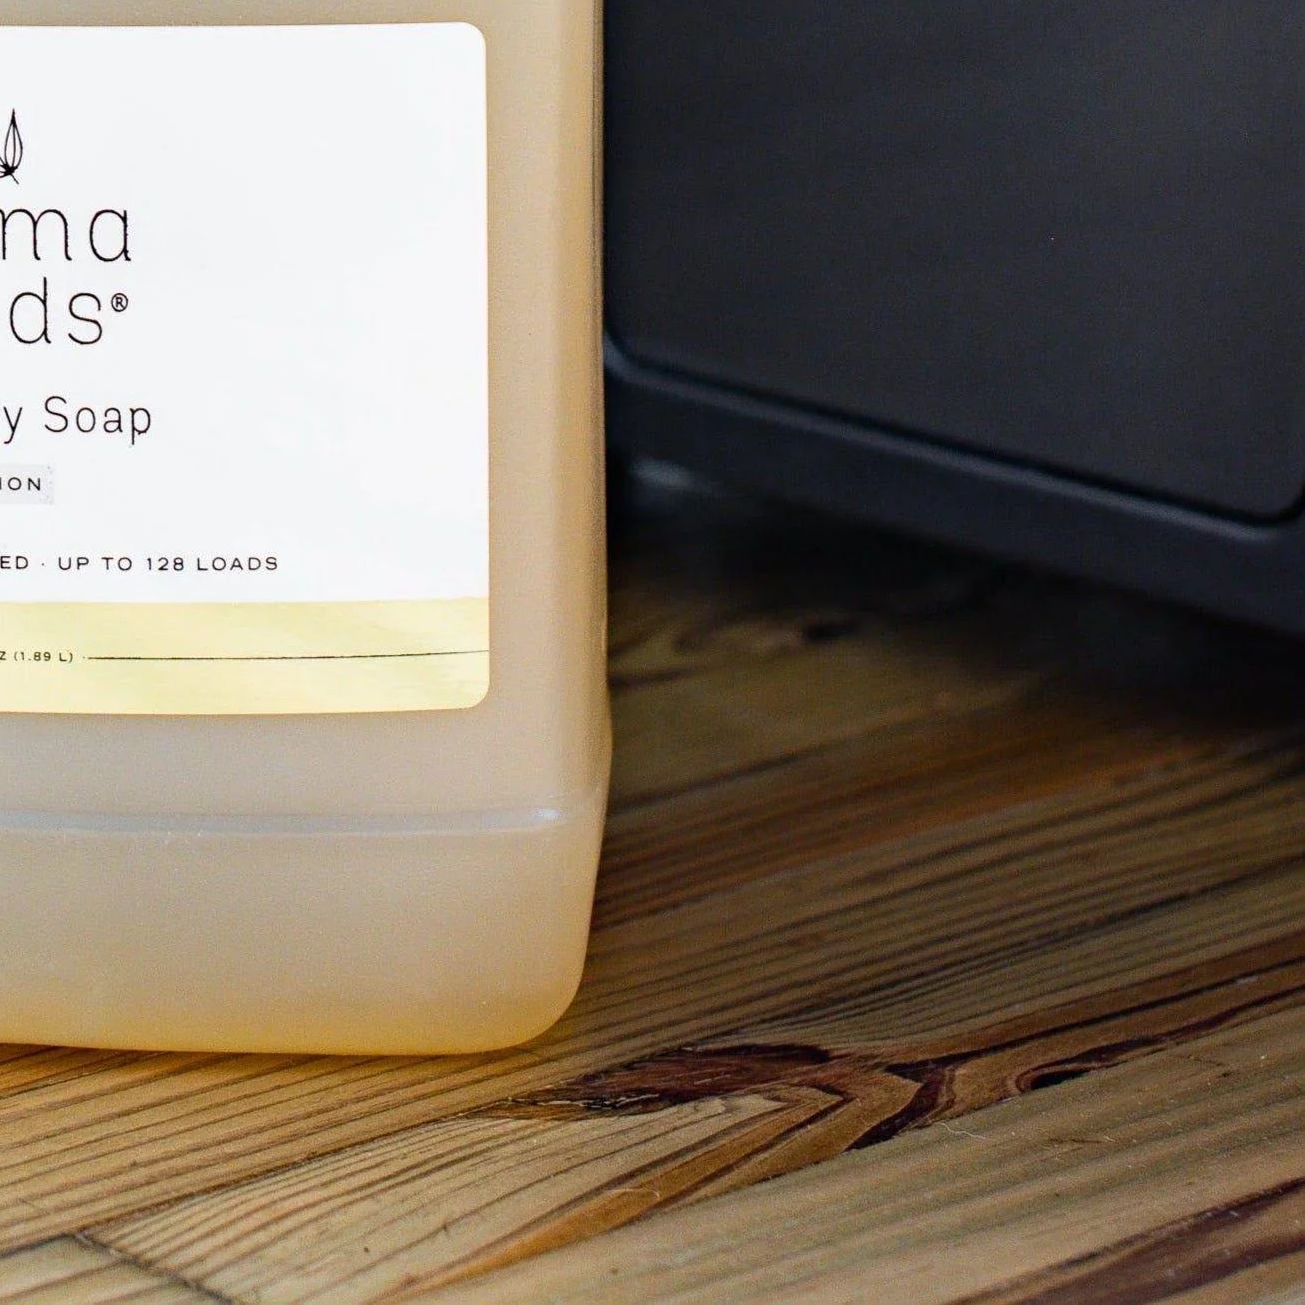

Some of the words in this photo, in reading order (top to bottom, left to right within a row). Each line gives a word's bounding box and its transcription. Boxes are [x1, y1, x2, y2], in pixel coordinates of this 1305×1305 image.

[43, 395, 152, 446] Soap
[57, 556, 90, 572] UP
[100, 556, 133, 572] TO
[146, 556, 185, 572] 128
[196, 556, 278, 572] LOADS
[13, 649, 52, 663] (1.89
[58, 650, 76, 664] L)
